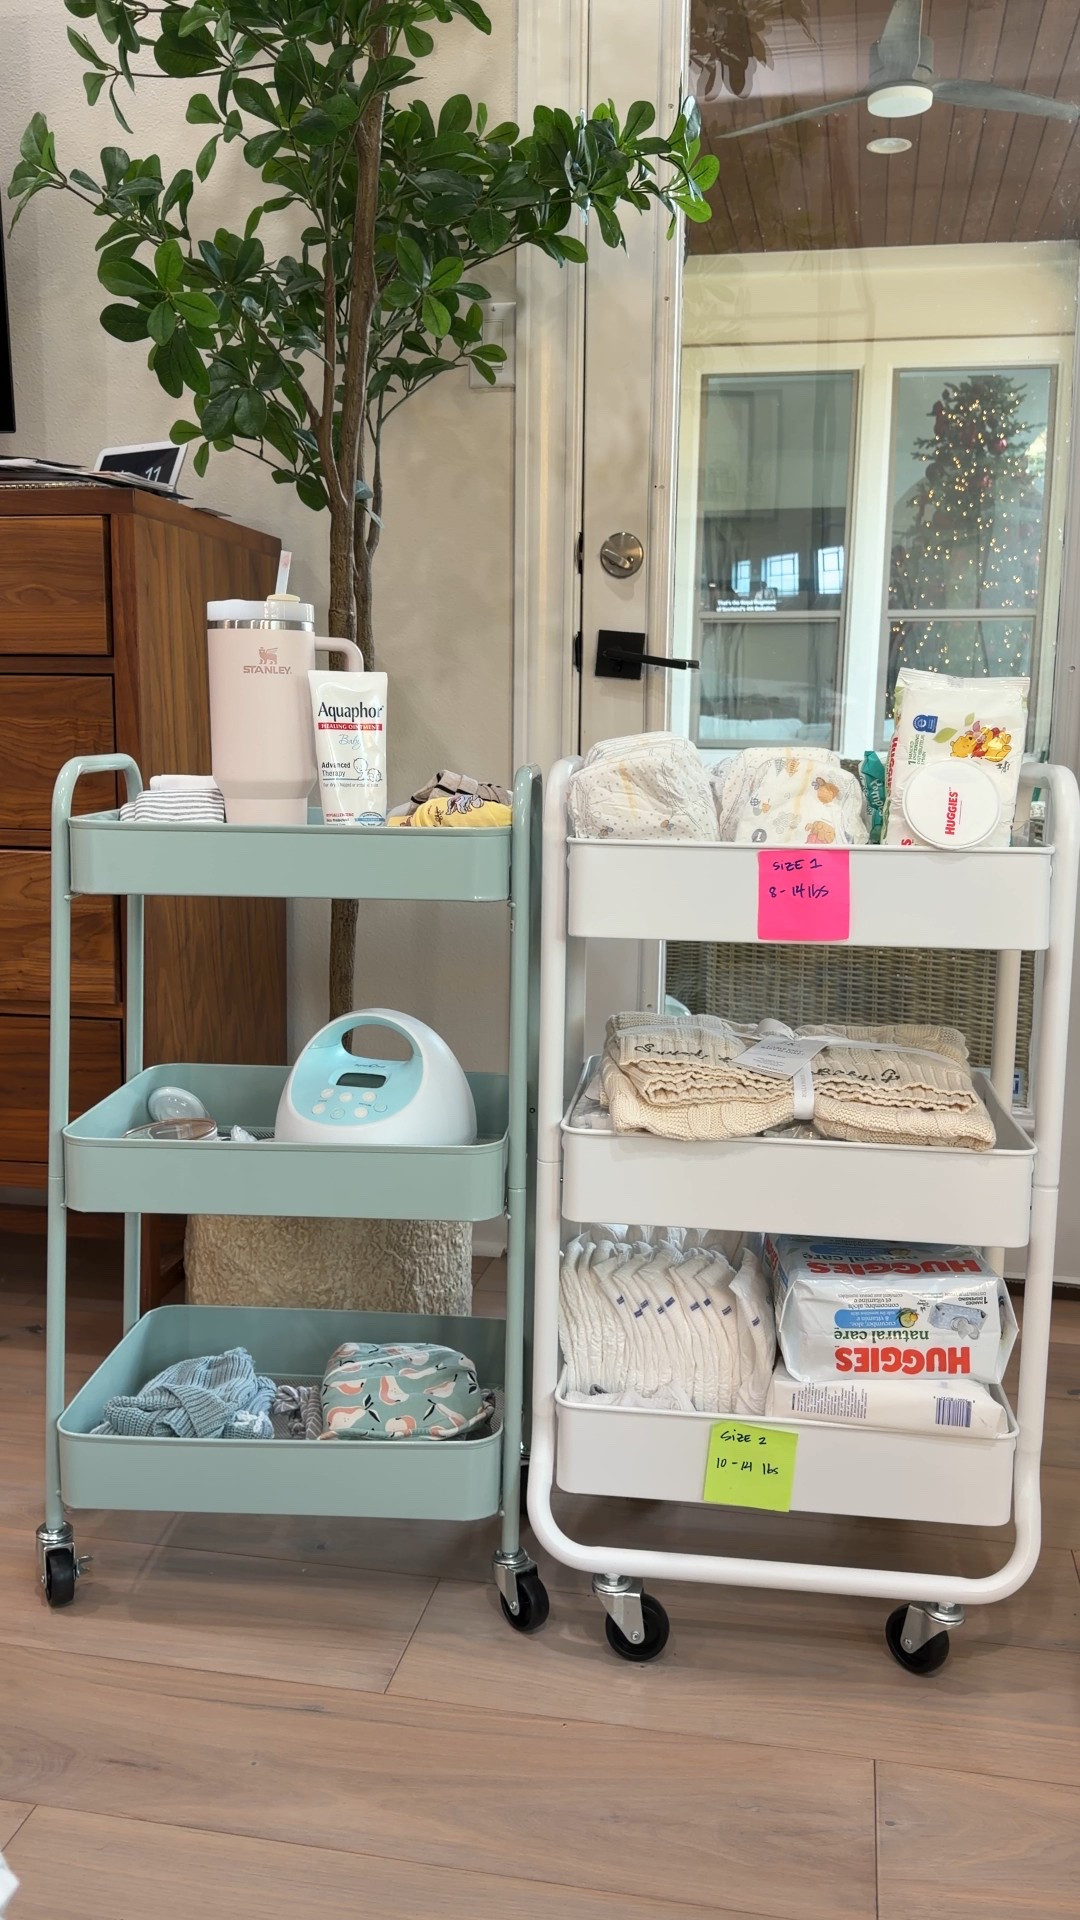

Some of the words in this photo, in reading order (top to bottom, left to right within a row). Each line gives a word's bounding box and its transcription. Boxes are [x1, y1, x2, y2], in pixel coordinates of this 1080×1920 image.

[243, 665, 292, 675] STANLEY
[318, 701, 383, 722] Aquaphor
[321, 761, 351, 769] Advanced
[945, 790, 958, 835] HUGGIES
[810, 858, 822, 869] 1
[769, 886, 777, 898] 8
[792, 883, 805, 898] 14
[803, 1253, 843, 1262] care
[806, 1259, 982, 1275] HUGGIES
[866, 1320, 897, 1328] cucumber,
[834, 1330, 868, 1341] care
[871, 1330, 929, 1344] natural
[835, 1347, 970, 1375] HUGGIES
[759, 1437, 767, 1445] 2
[717, 1457, 727, 1468] 10
